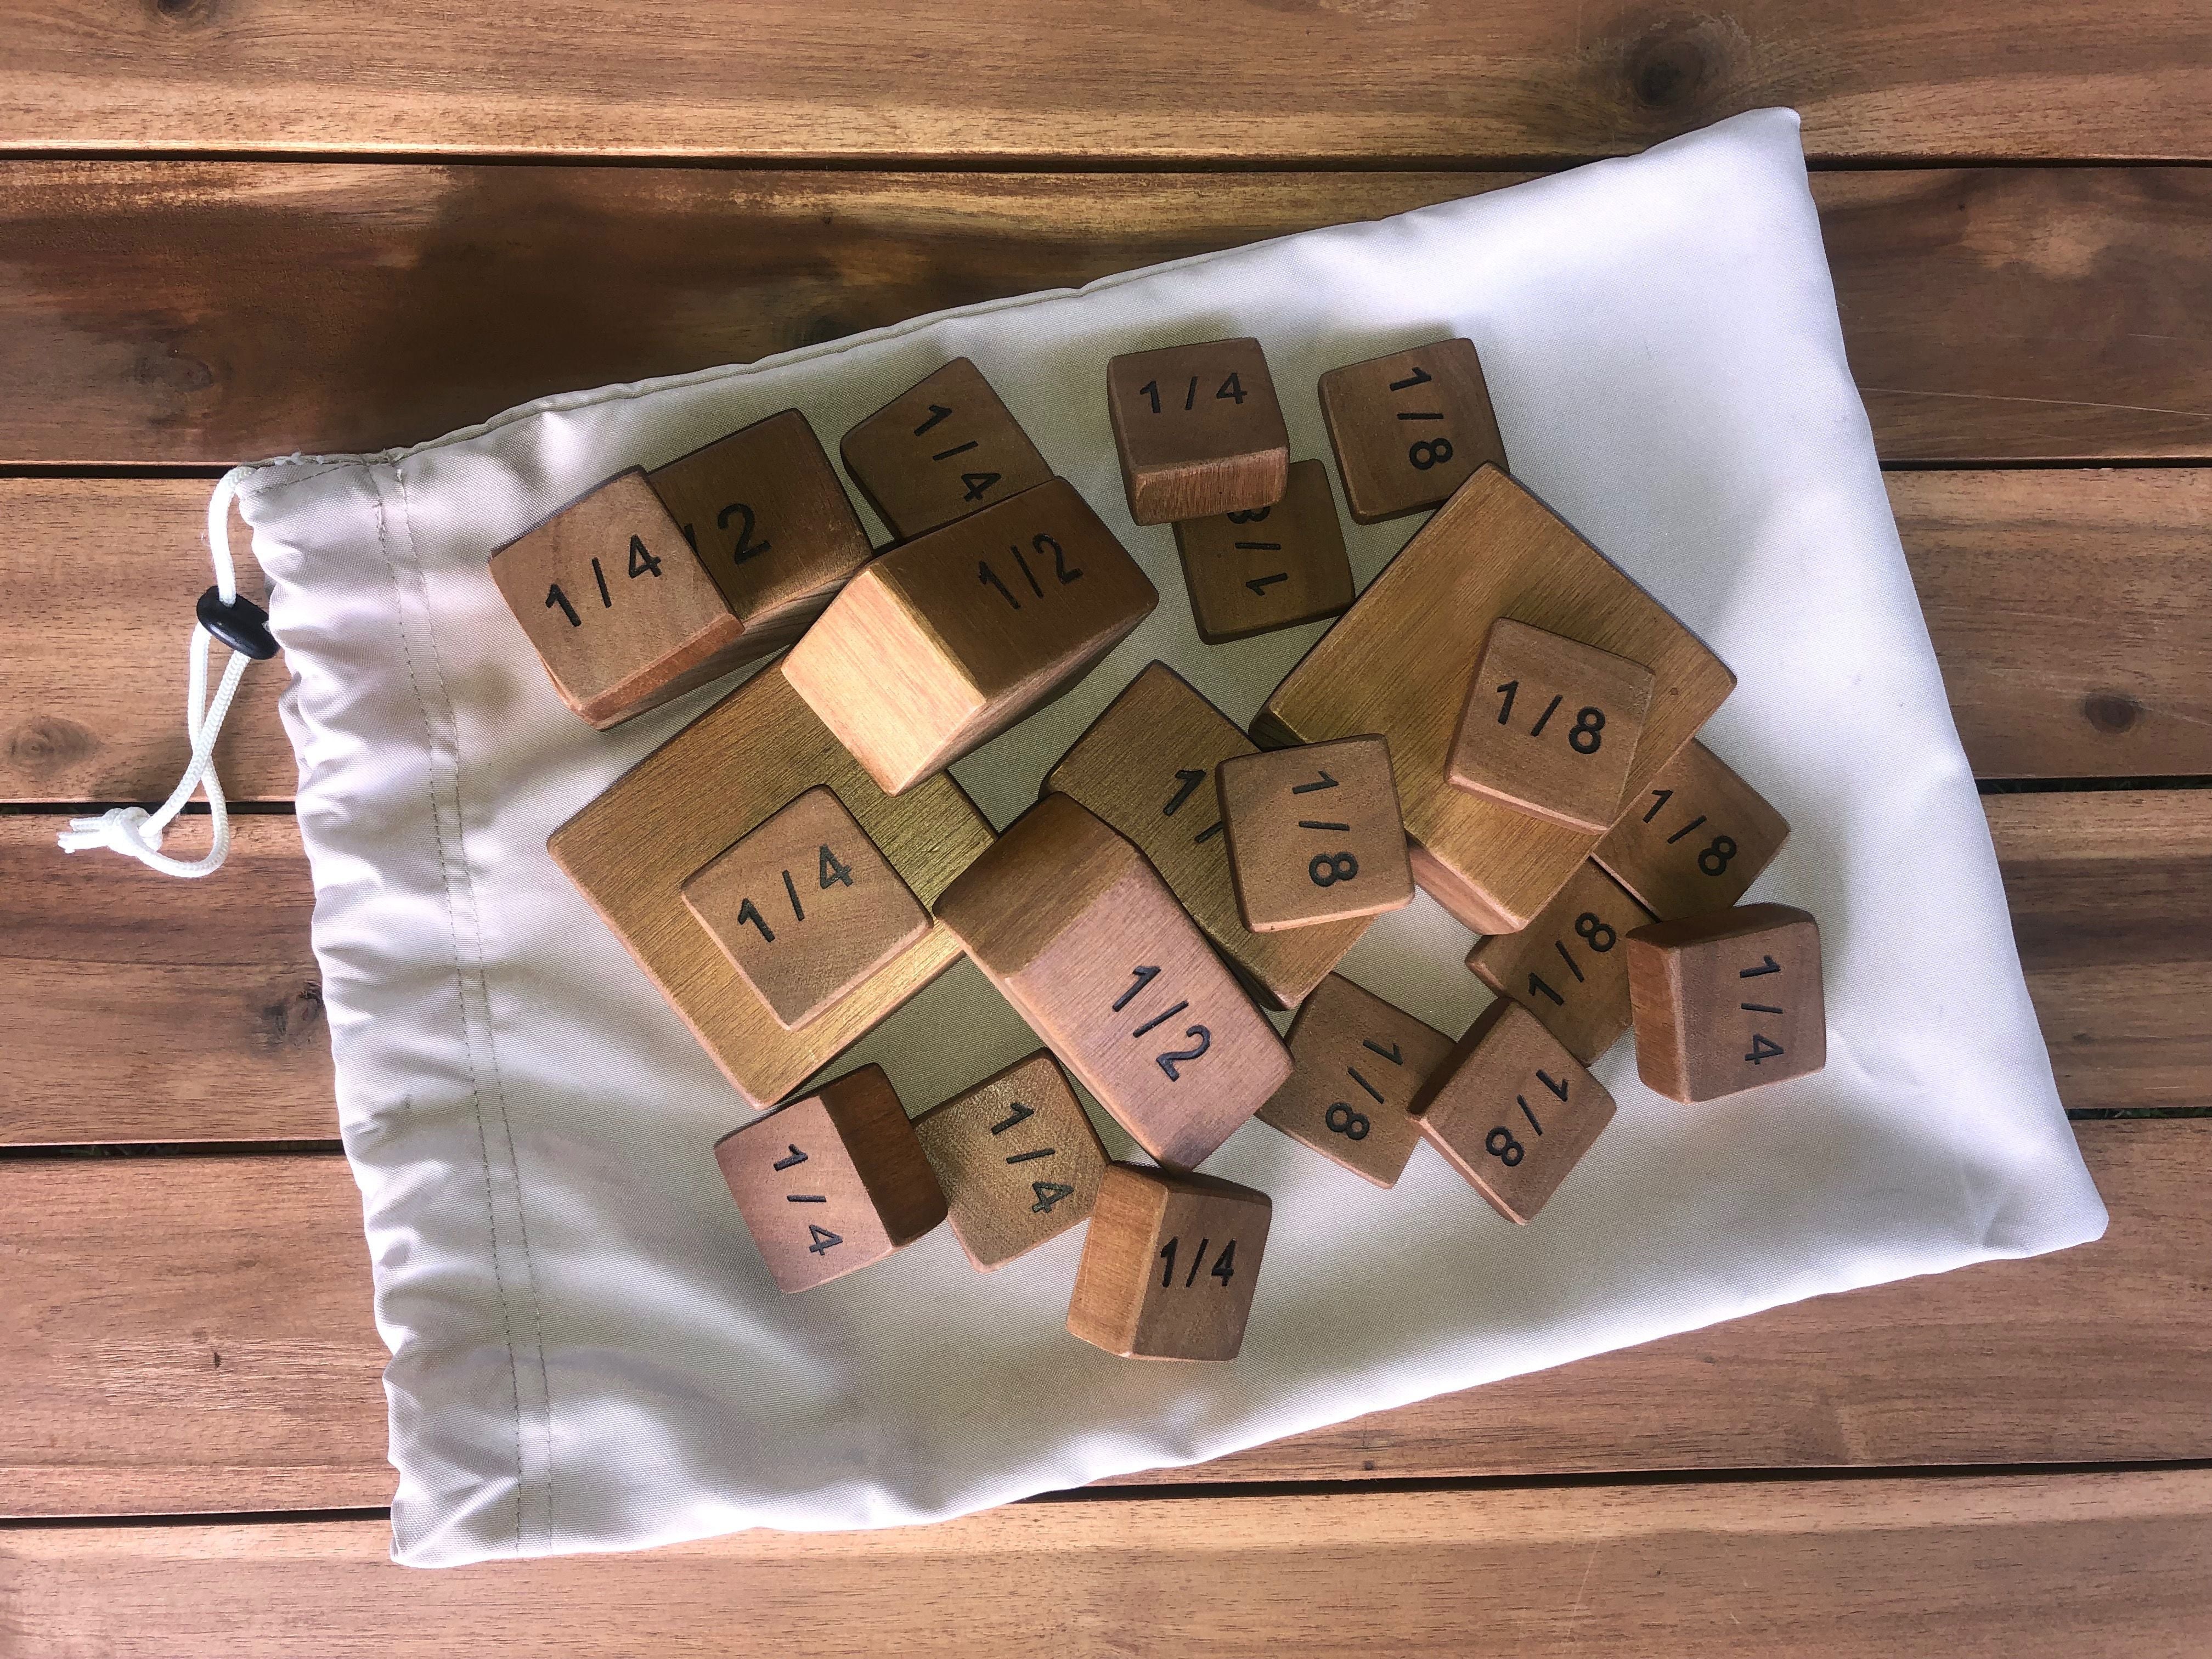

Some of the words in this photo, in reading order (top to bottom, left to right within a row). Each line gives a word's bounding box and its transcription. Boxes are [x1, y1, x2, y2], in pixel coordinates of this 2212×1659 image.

[1138, 370, 1250, 416] 1/4
[1388, 366, 1454, 471] 1/8
[913, 404, 1002, 502] 1/4
[545, 534, 662, 628] 1/4
[978, 532, 1084, 610] 1/2
[1496, 680, 1606, 755] 1/8
[1291, 770, 1359, 888] 1/8
[1643, 789, 1737, 877] 1/8
[738, 843, 854, 943] 1/4
[1527, 912, 1617, 1007] 1/8
[1112, 964, 1211, 1082] 1/2
[1740, 955, 1785, 1065] 1/4
[1325, 1039, 1403, 1141] 1/8
[1485, 1069, 1569, 1167] 1/8
[773, 1144, 844, 1256] 1/4
[990, 1101, 1075, 1214] 1/4
[1160, 1237, 1237, 1288] 1/4
